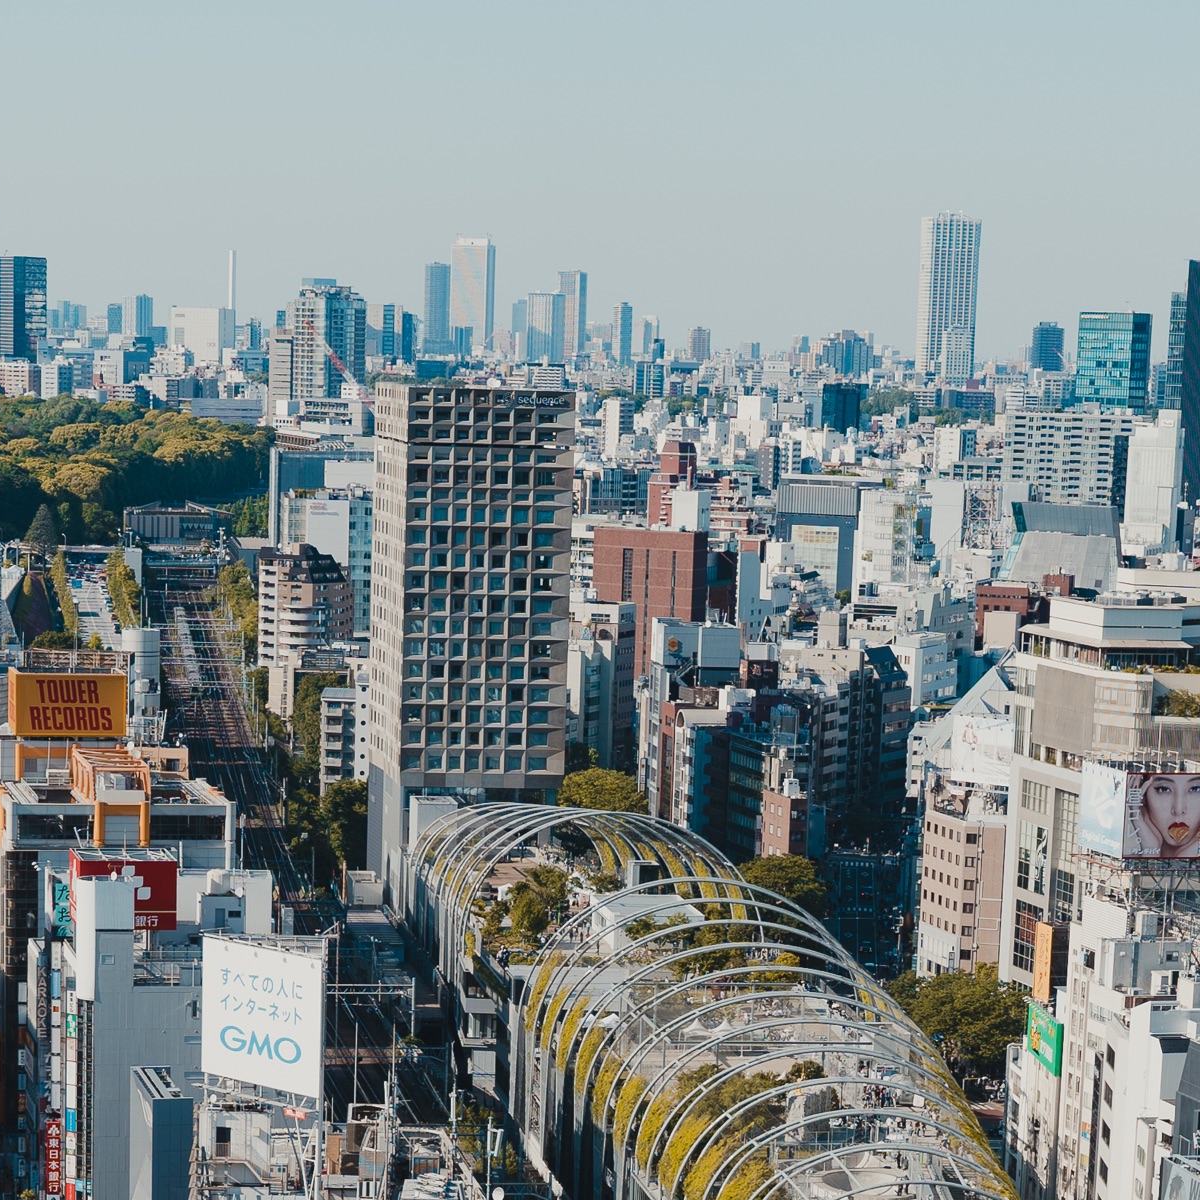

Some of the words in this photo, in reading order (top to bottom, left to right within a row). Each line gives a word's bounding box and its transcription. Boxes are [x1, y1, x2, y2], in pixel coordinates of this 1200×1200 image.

[518, 396, 565, 407] sequence
[35, 679, 101, 705] TOWER
[29, 705, 114, 732] RECORDS
[135, 913, 160, 928] 銀行
[220, 967, 304, 1001] すべての人に
[36, 966, 48, 1039] KARAOKE
[220, 993, 303, 1026] インターネット
[219, 1025, 303, 1065] GMO
[47, 1138, 60, 1193] 東日本銀行
